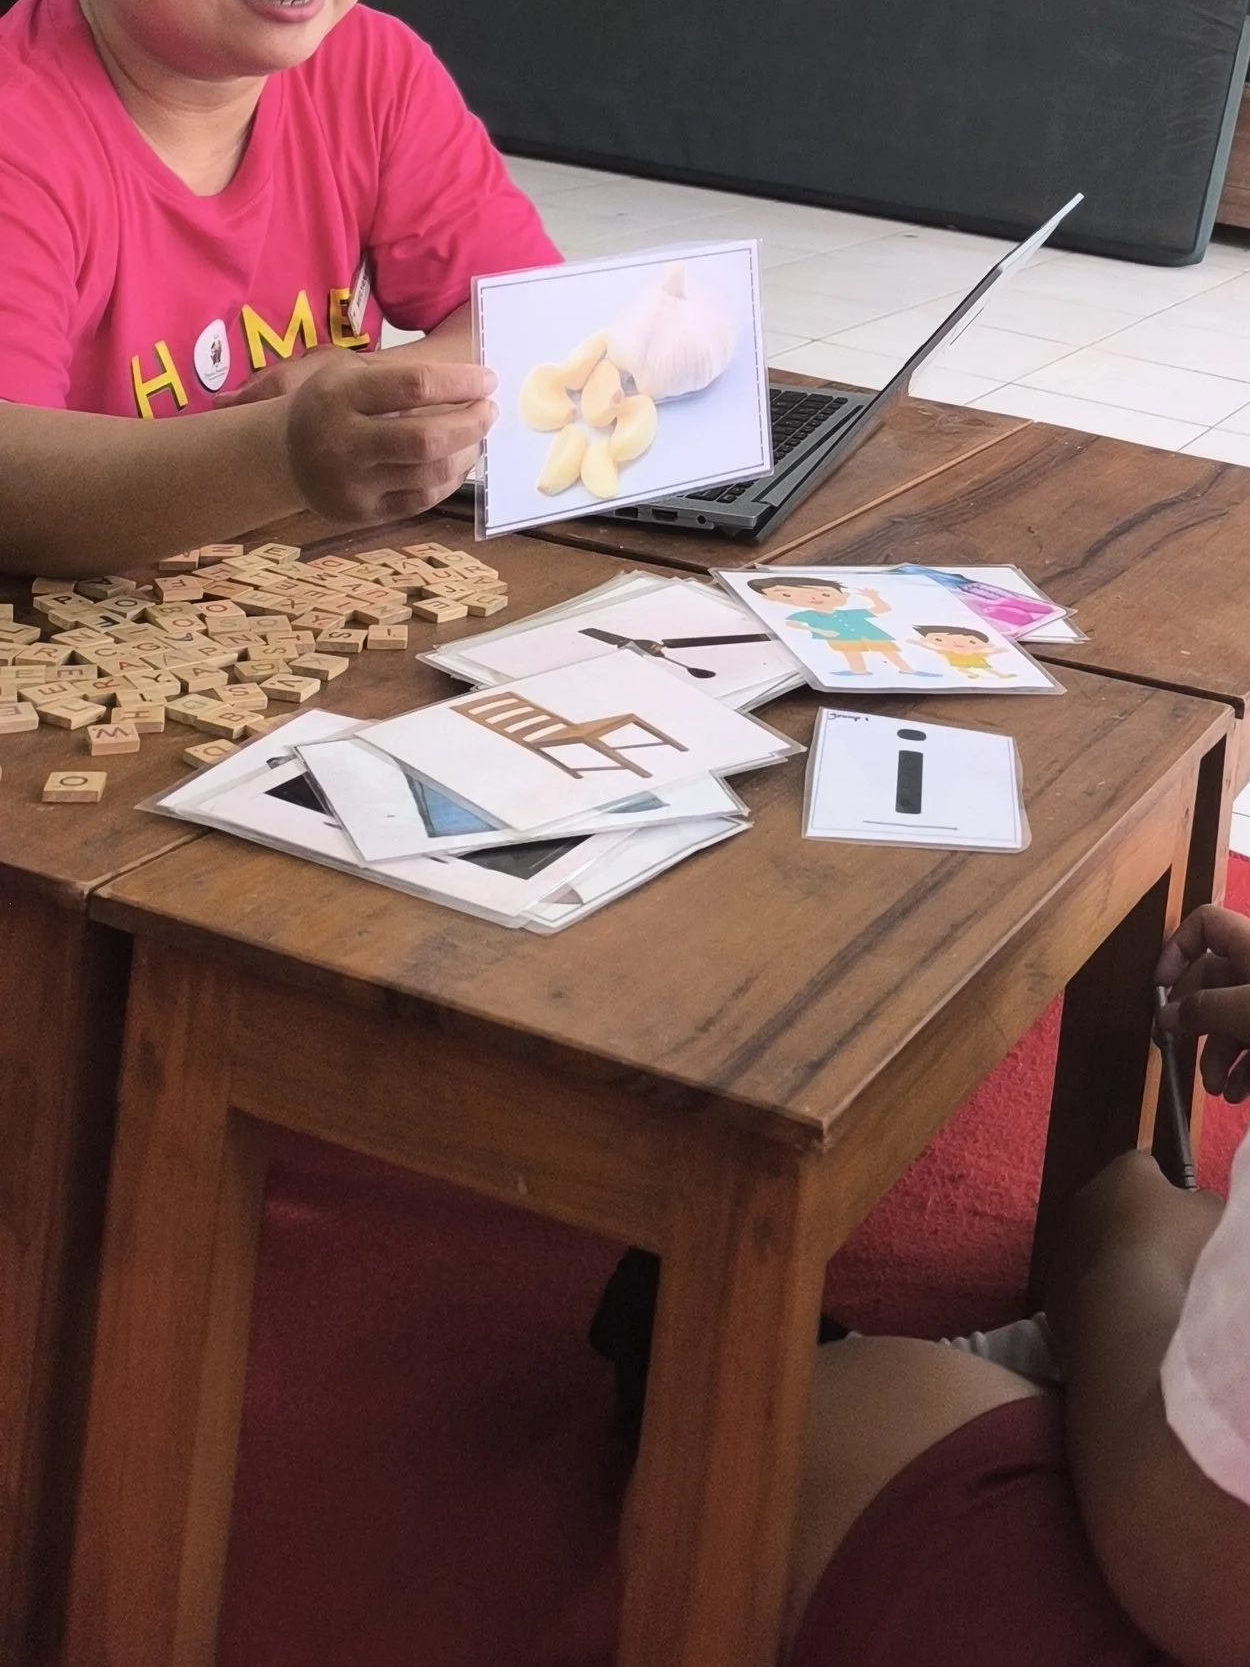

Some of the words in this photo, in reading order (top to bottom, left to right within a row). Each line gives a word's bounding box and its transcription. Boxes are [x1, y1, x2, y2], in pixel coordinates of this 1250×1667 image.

[131, 288, 370, 419] HME
[115, 599, 138, 607] O
[427, 600, 450, 610] E
[206, 604, 228, 613] O
[172, 618, 194, 628] O
[257, 618, 279, 627] O
[328, 631, 352, 639] S
[34, 647, 58, 657] R
[263, 646, 287, 655] S
[219, 712, 245, 722] B
[60, 776, 88, 787] O
